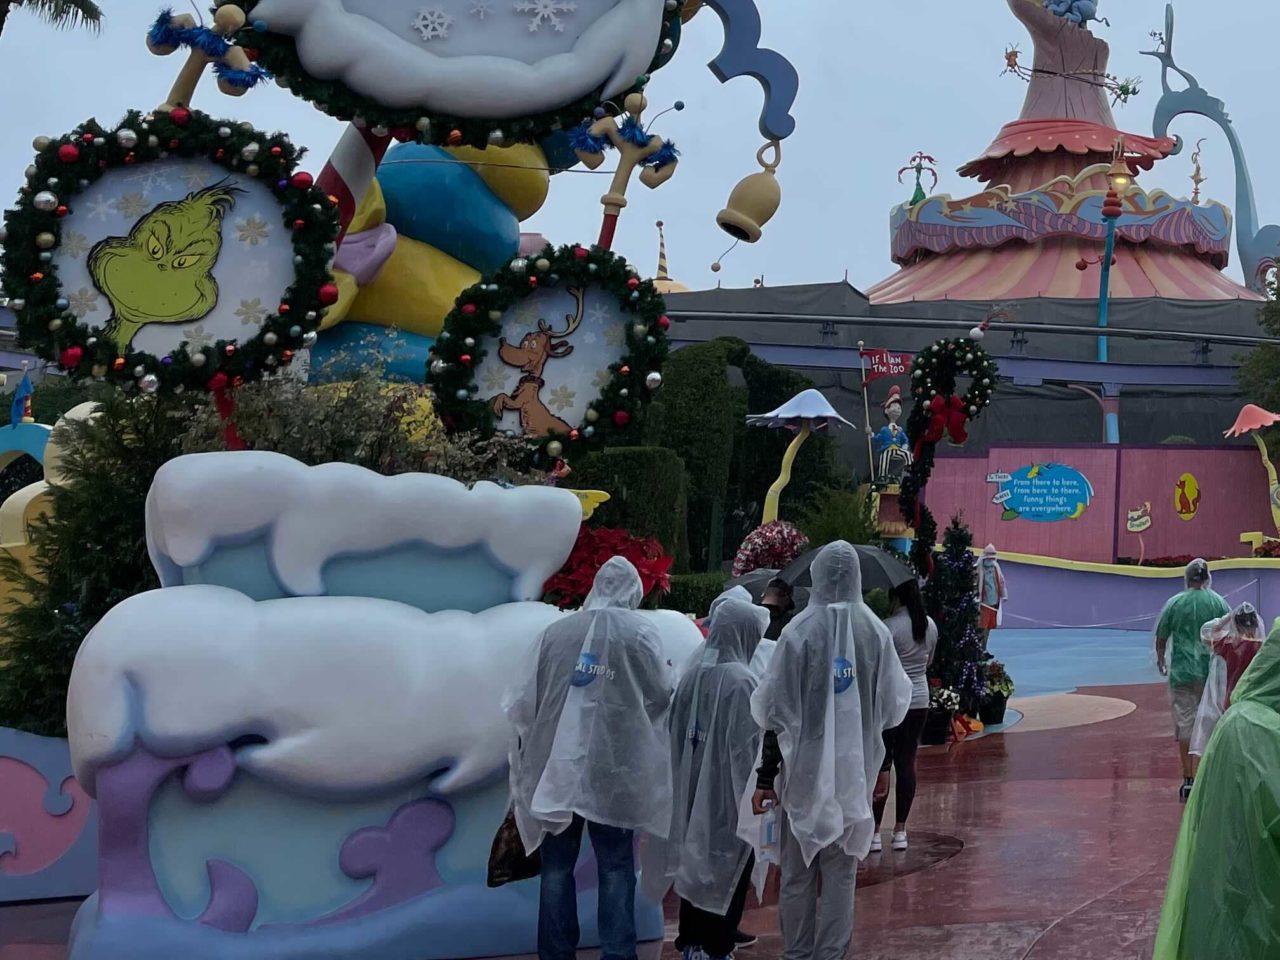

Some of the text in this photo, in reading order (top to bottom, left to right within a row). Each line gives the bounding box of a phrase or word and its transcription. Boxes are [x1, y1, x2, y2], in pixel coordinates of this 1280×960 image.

[889, 365, 905, 374] ZOO
[1032, 478, 1051, 487] there
[1053, 478, 1060, 487] to
[1051, 488, 1060, 496] to
[1045, 495, 1067, 506] things
